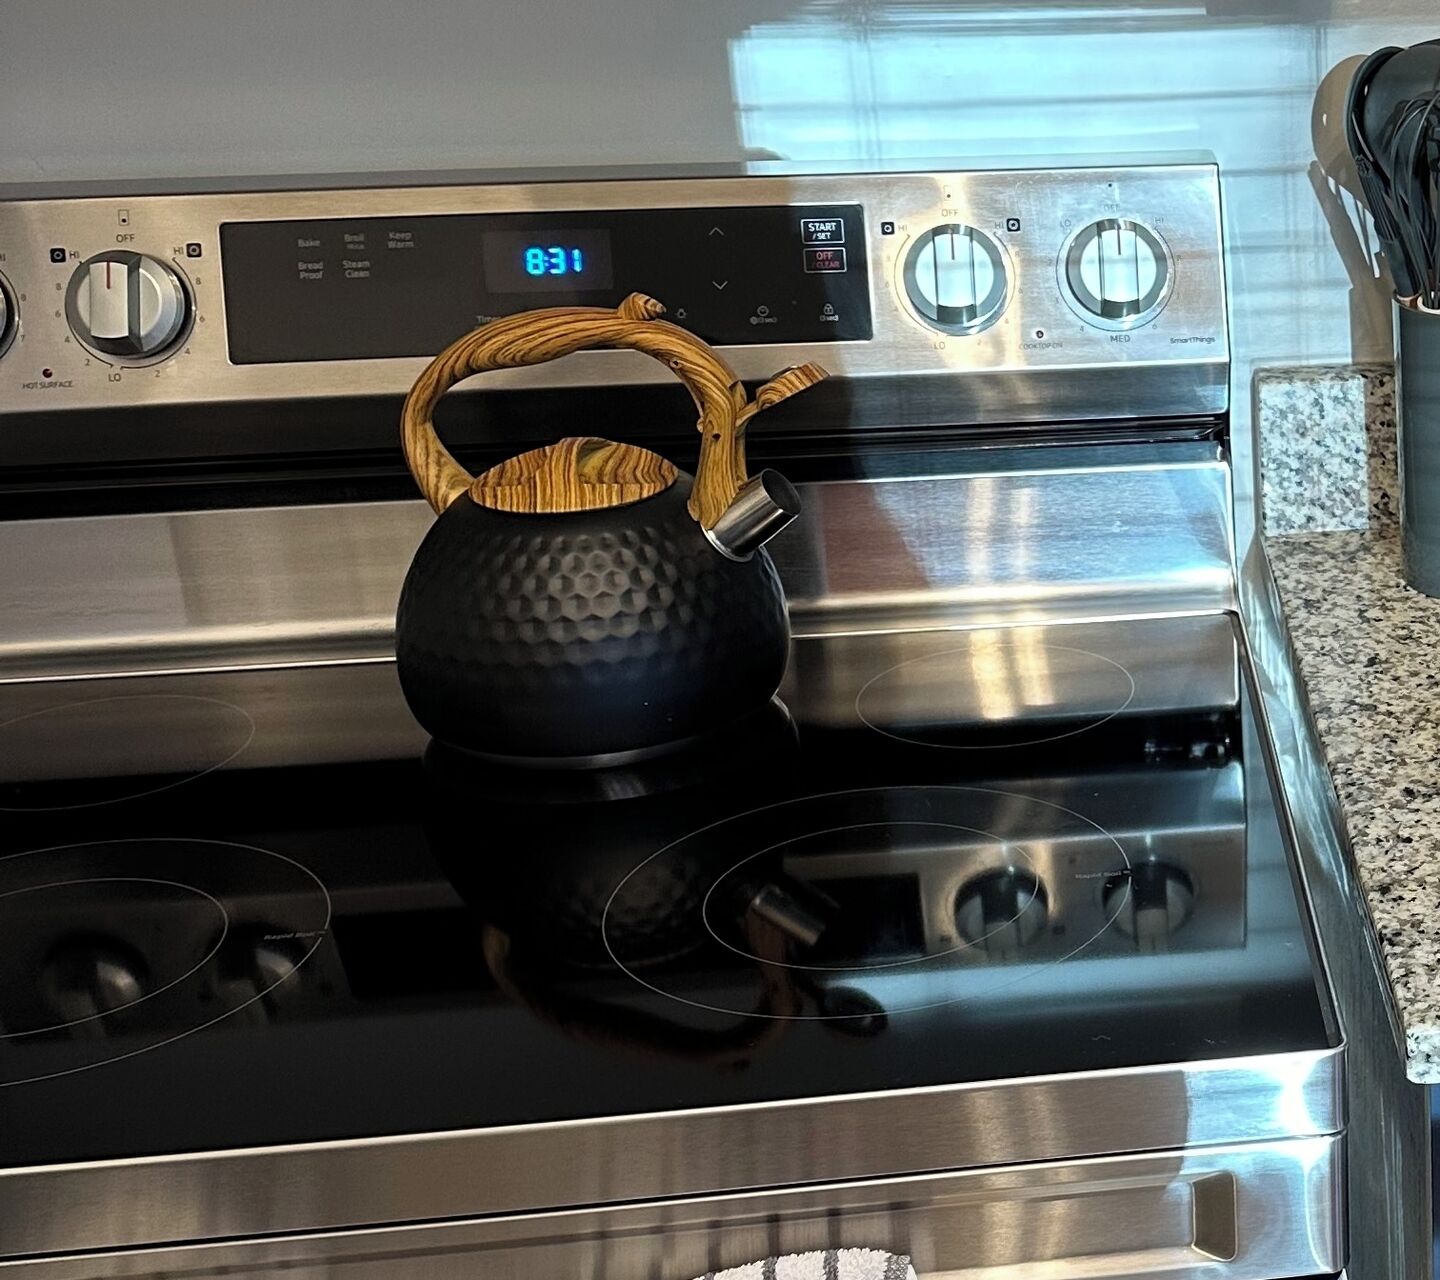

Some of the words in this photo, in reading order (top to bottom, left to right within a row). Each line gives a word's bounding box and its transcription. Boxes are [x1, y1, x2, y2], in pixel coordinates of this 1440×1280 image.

[807, 222, 837, 232] START
[115, 234, 136, 243] OFF
[69, 251, 80, 259] HI
[174, 247, 184, 255] HI
[526, 247, 582, 274] 8:31
[1110, 335, 1131, 343] MED
[108, 373, 122, 382] LO
